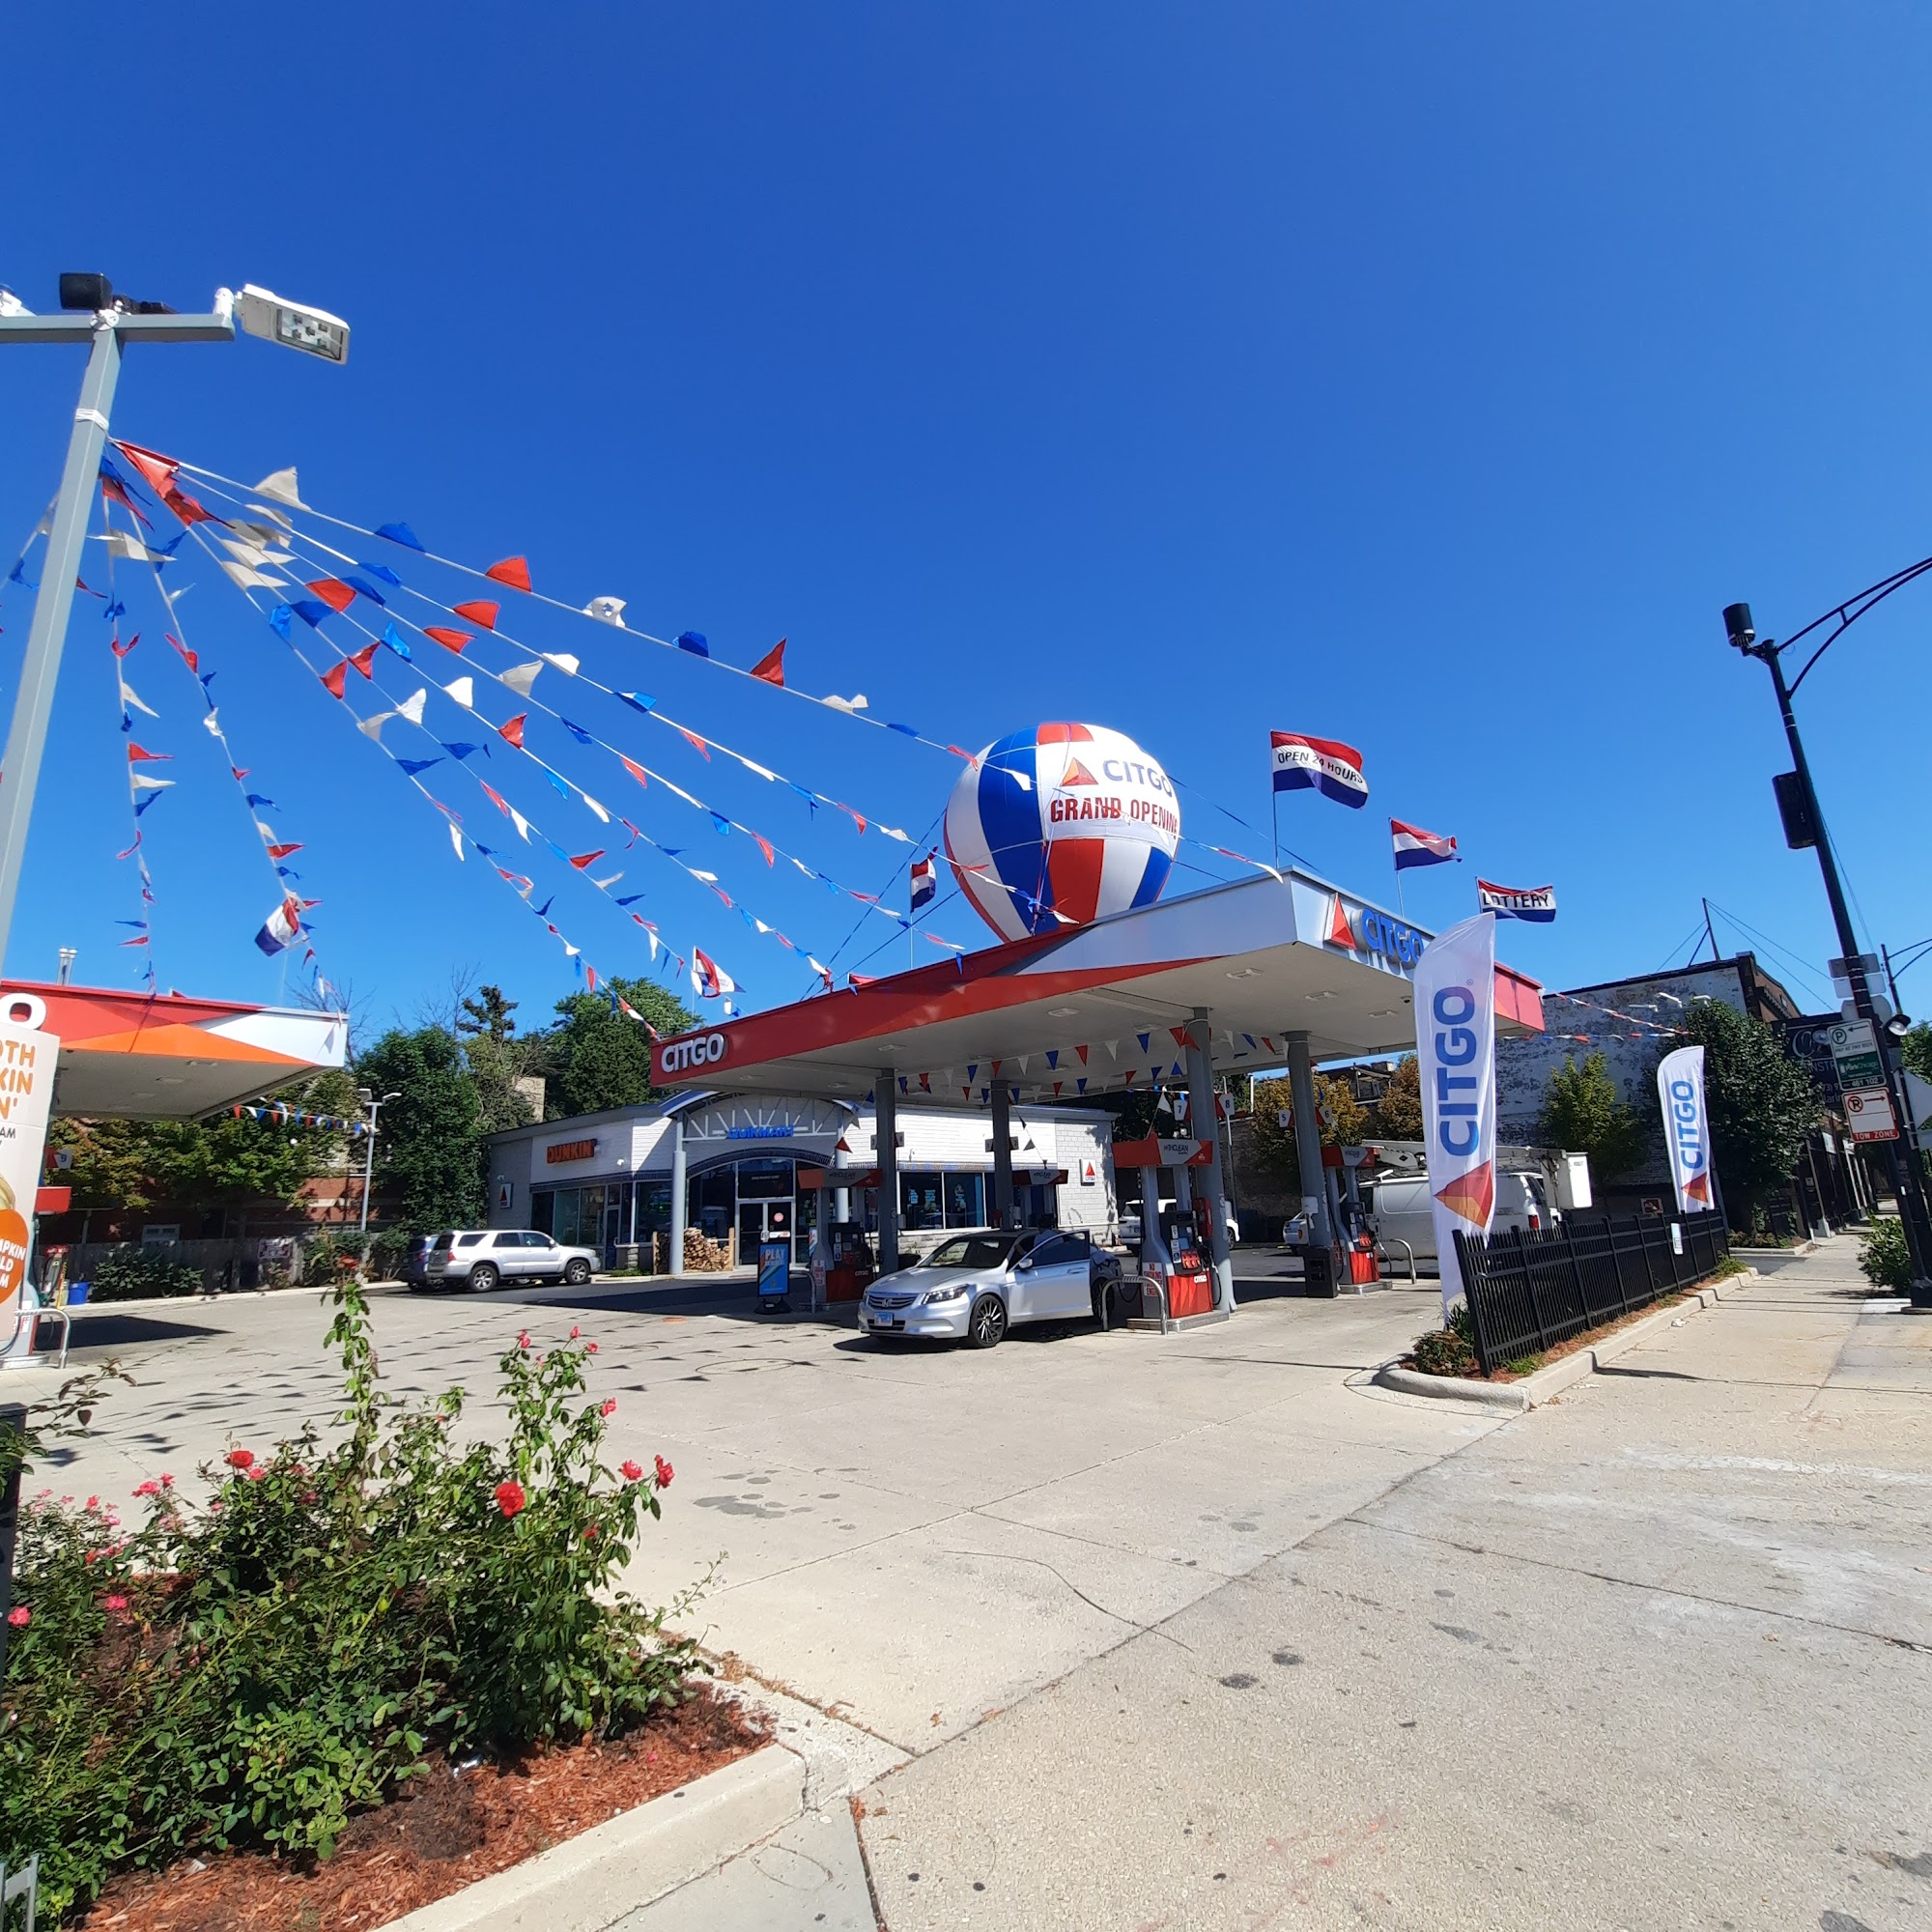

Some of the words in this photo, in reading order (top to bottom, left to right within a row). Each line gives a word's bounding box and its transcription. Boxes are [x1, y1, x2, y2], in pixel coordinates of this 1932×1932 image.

[1102, 760, 1173, 798] CITGO
[1278, 752, 1309, 763] OPEN
[1327, 762, 1363, 783] HOURS
[1051, 797, 1122, 822] GRAND
[1483, 893, 1548, 907] LOTTERY
[1360, 906, 1425, 964] CITGO
[661, 1033, 724, 1073] CITGO
[1434, 986, 1479, 1156] CITGO
[1177, 1105, 1182, 1114] 7
[1225, 1099, 1230, 1108] 8
[727, 1125, 795, 1139] QUIKMART
[1671, 1080, 1703, 1170] CITGO
[765, 1248, 785, 1260] PLAY
